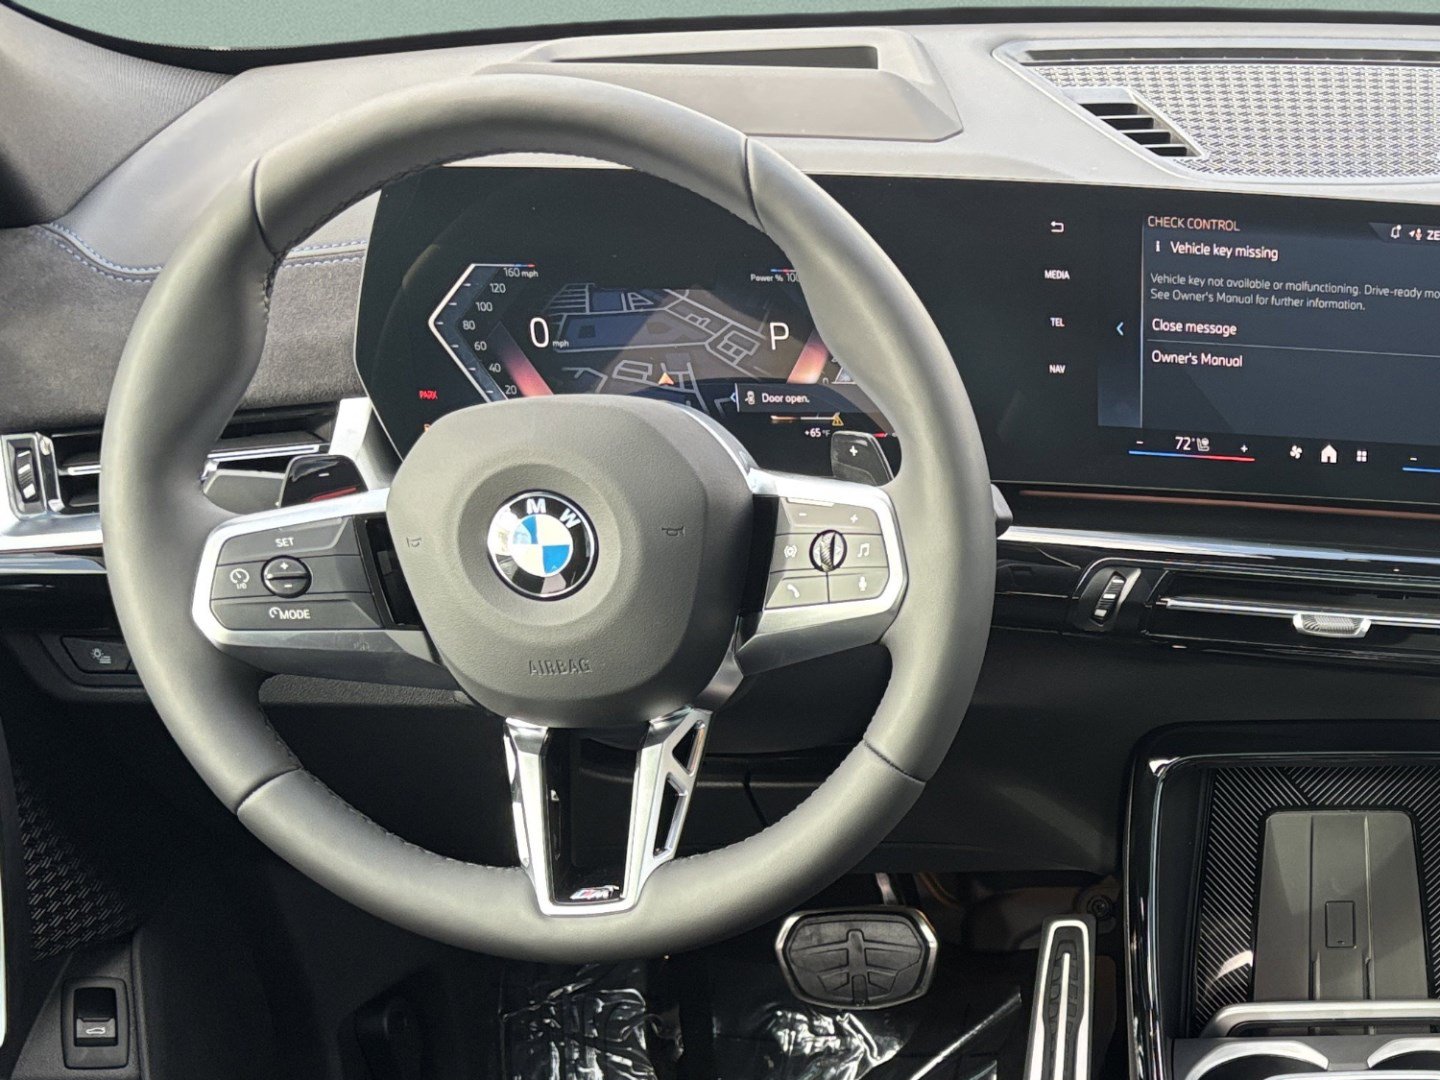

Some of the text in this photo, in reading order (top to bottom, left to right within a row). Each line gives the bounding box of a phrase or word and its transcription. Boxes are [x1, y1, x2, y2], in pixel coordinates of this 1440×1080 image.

[1147, 215, 1241, 232] CHECK CONTROL
[1170, 241, 1211, 256] Vehicle
[1212, 243, 1233, 259] key
[1235, 245, 1279, 262] missing
[503, 267, 539, 278] 160 mph
[750, 273, 774, 283] Power
[1044, 269, 1071, 280] MEDIA
[489, 283, 506, 294] 120
[1150, 272, 1186, 285] Vehicle
[1188, 275, 1206, 288] key
[1207, 276, 1225, 288] not
[1226, 278, 1271, 290] available
[1272, 281, 1284, 290] or
[1285, 280, 1361, 297] malfunctioning.
[1364, 284, 1422, 299] Drive-ready
[1150, 288, 1366, 311] See Owner's Manual for further information.
[475, 301, 493, 312] 100
[462, 320, 476, 331] 80
[1050, 317, 1066, 327] TEL
[529, 317, 549, 348] 0
[1151, 318, 1238, 338] Close message
[769, 322, 790, 350] P
[474, 341, 487, 351] 60
[552, 339, 570, 348] mph
[1151, 349, 1243, 367] Owner's Manual
[488, 363, 501, 373] 40
[1049, 364, 1066, 374] NAV
[505, 384, 517, 395] 20
[761, 392, 811, 405] Door open.
[804, 427, 821, 438] +65
[275, 537, 294, 548] SET
[280, 609, 311, 620] MODE
[528, 658, 593, 676] AIRBAG
